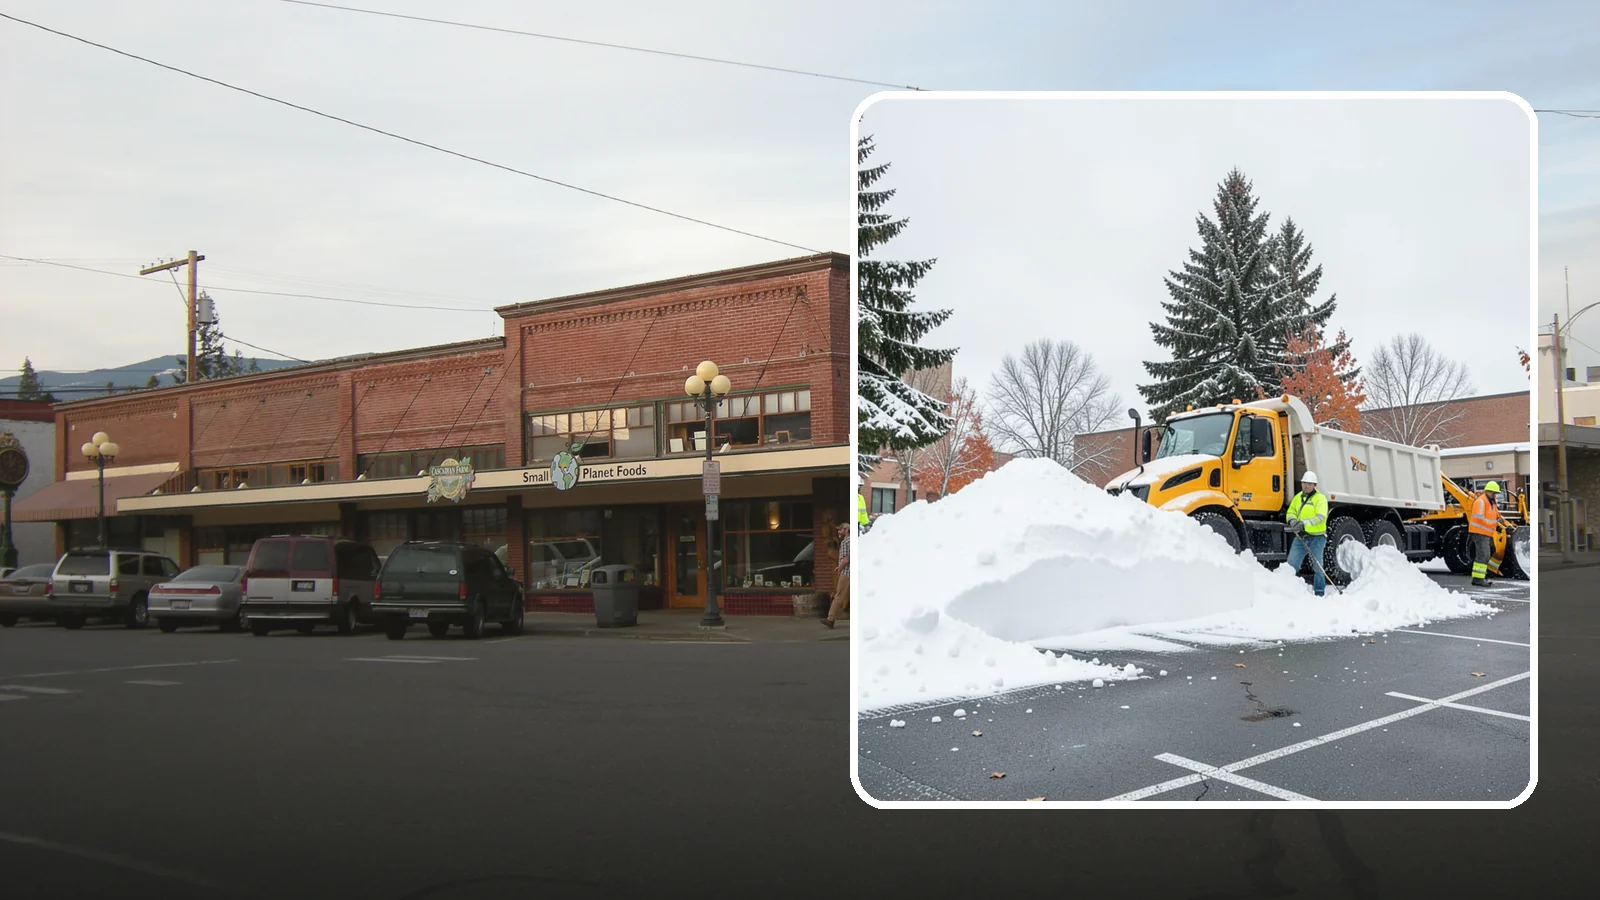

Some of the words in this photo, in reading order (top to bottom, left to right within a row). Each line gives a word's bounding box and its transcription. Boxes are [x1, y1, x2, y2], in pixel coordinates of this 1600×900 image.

[523, 471, 549, 483] Small
[582, 467, 614, 479] Planet
[616, 464, 647, 476] Foods
